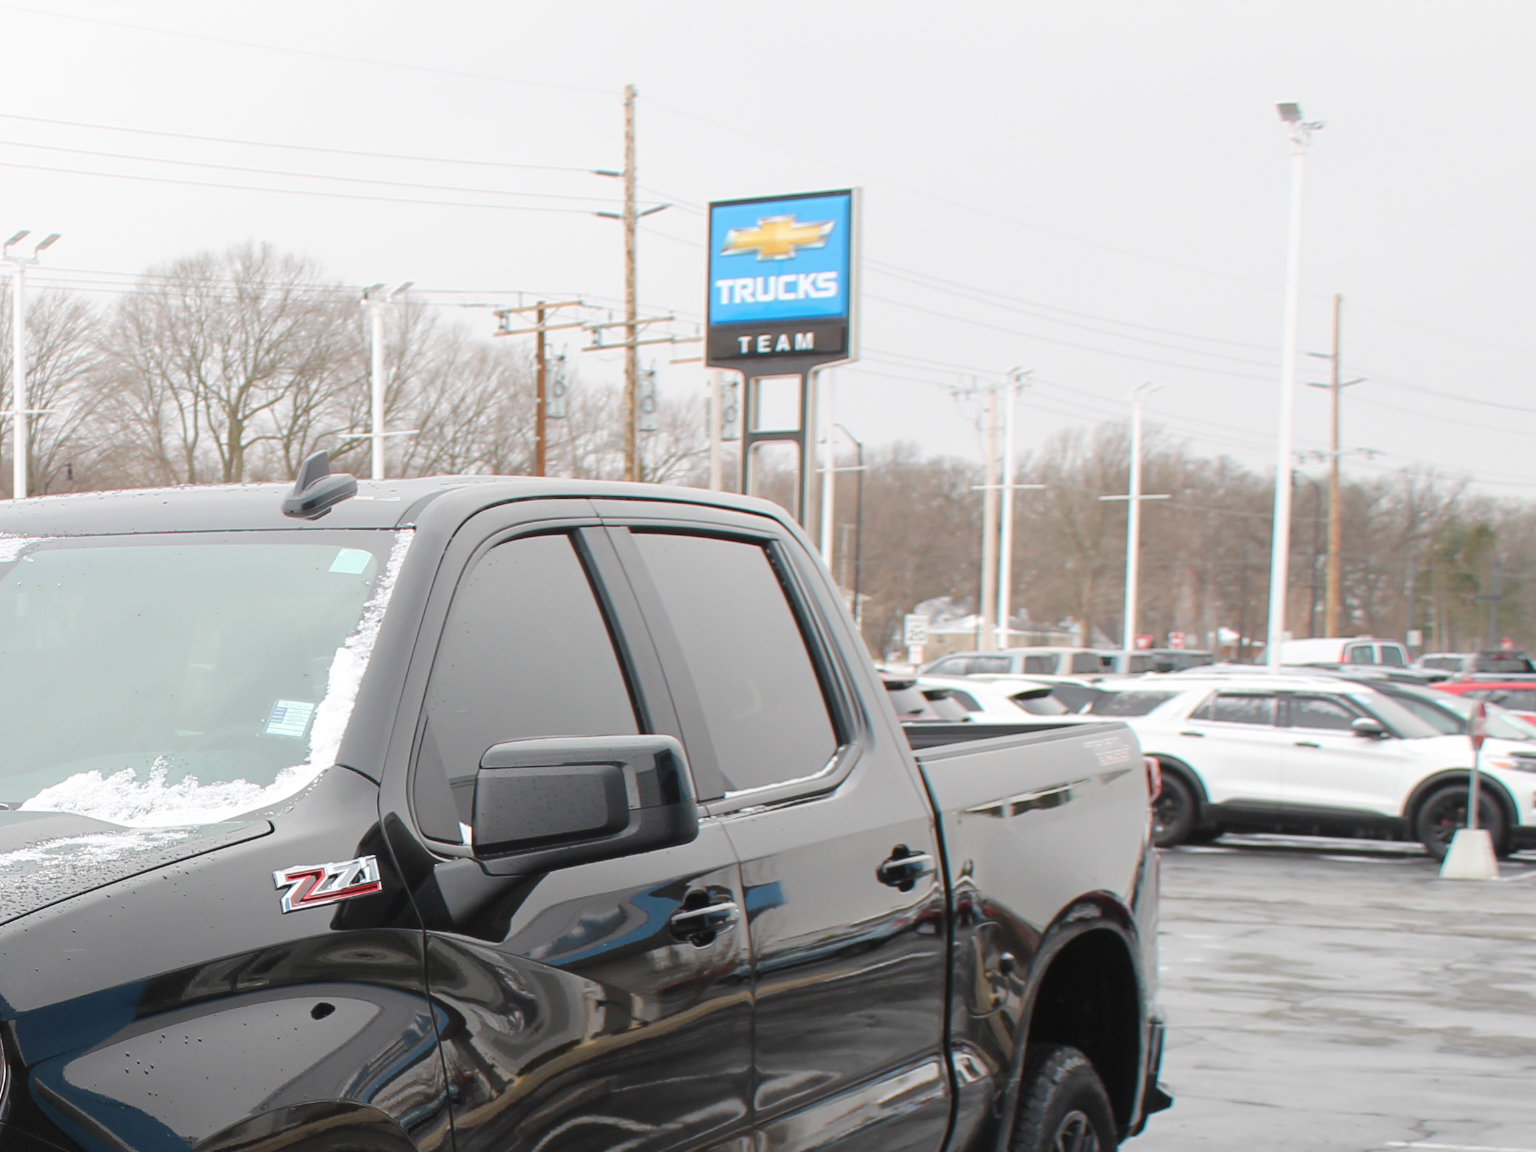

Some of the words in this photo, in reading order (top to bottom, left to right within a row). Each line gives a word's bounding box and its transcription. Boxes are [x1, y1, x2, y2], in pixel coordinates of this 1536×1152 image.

[716, 271, 839, 305] TRUCKS
[738, 332, 815, 354] TEAM
[273, 855, 382, 914] Z71
